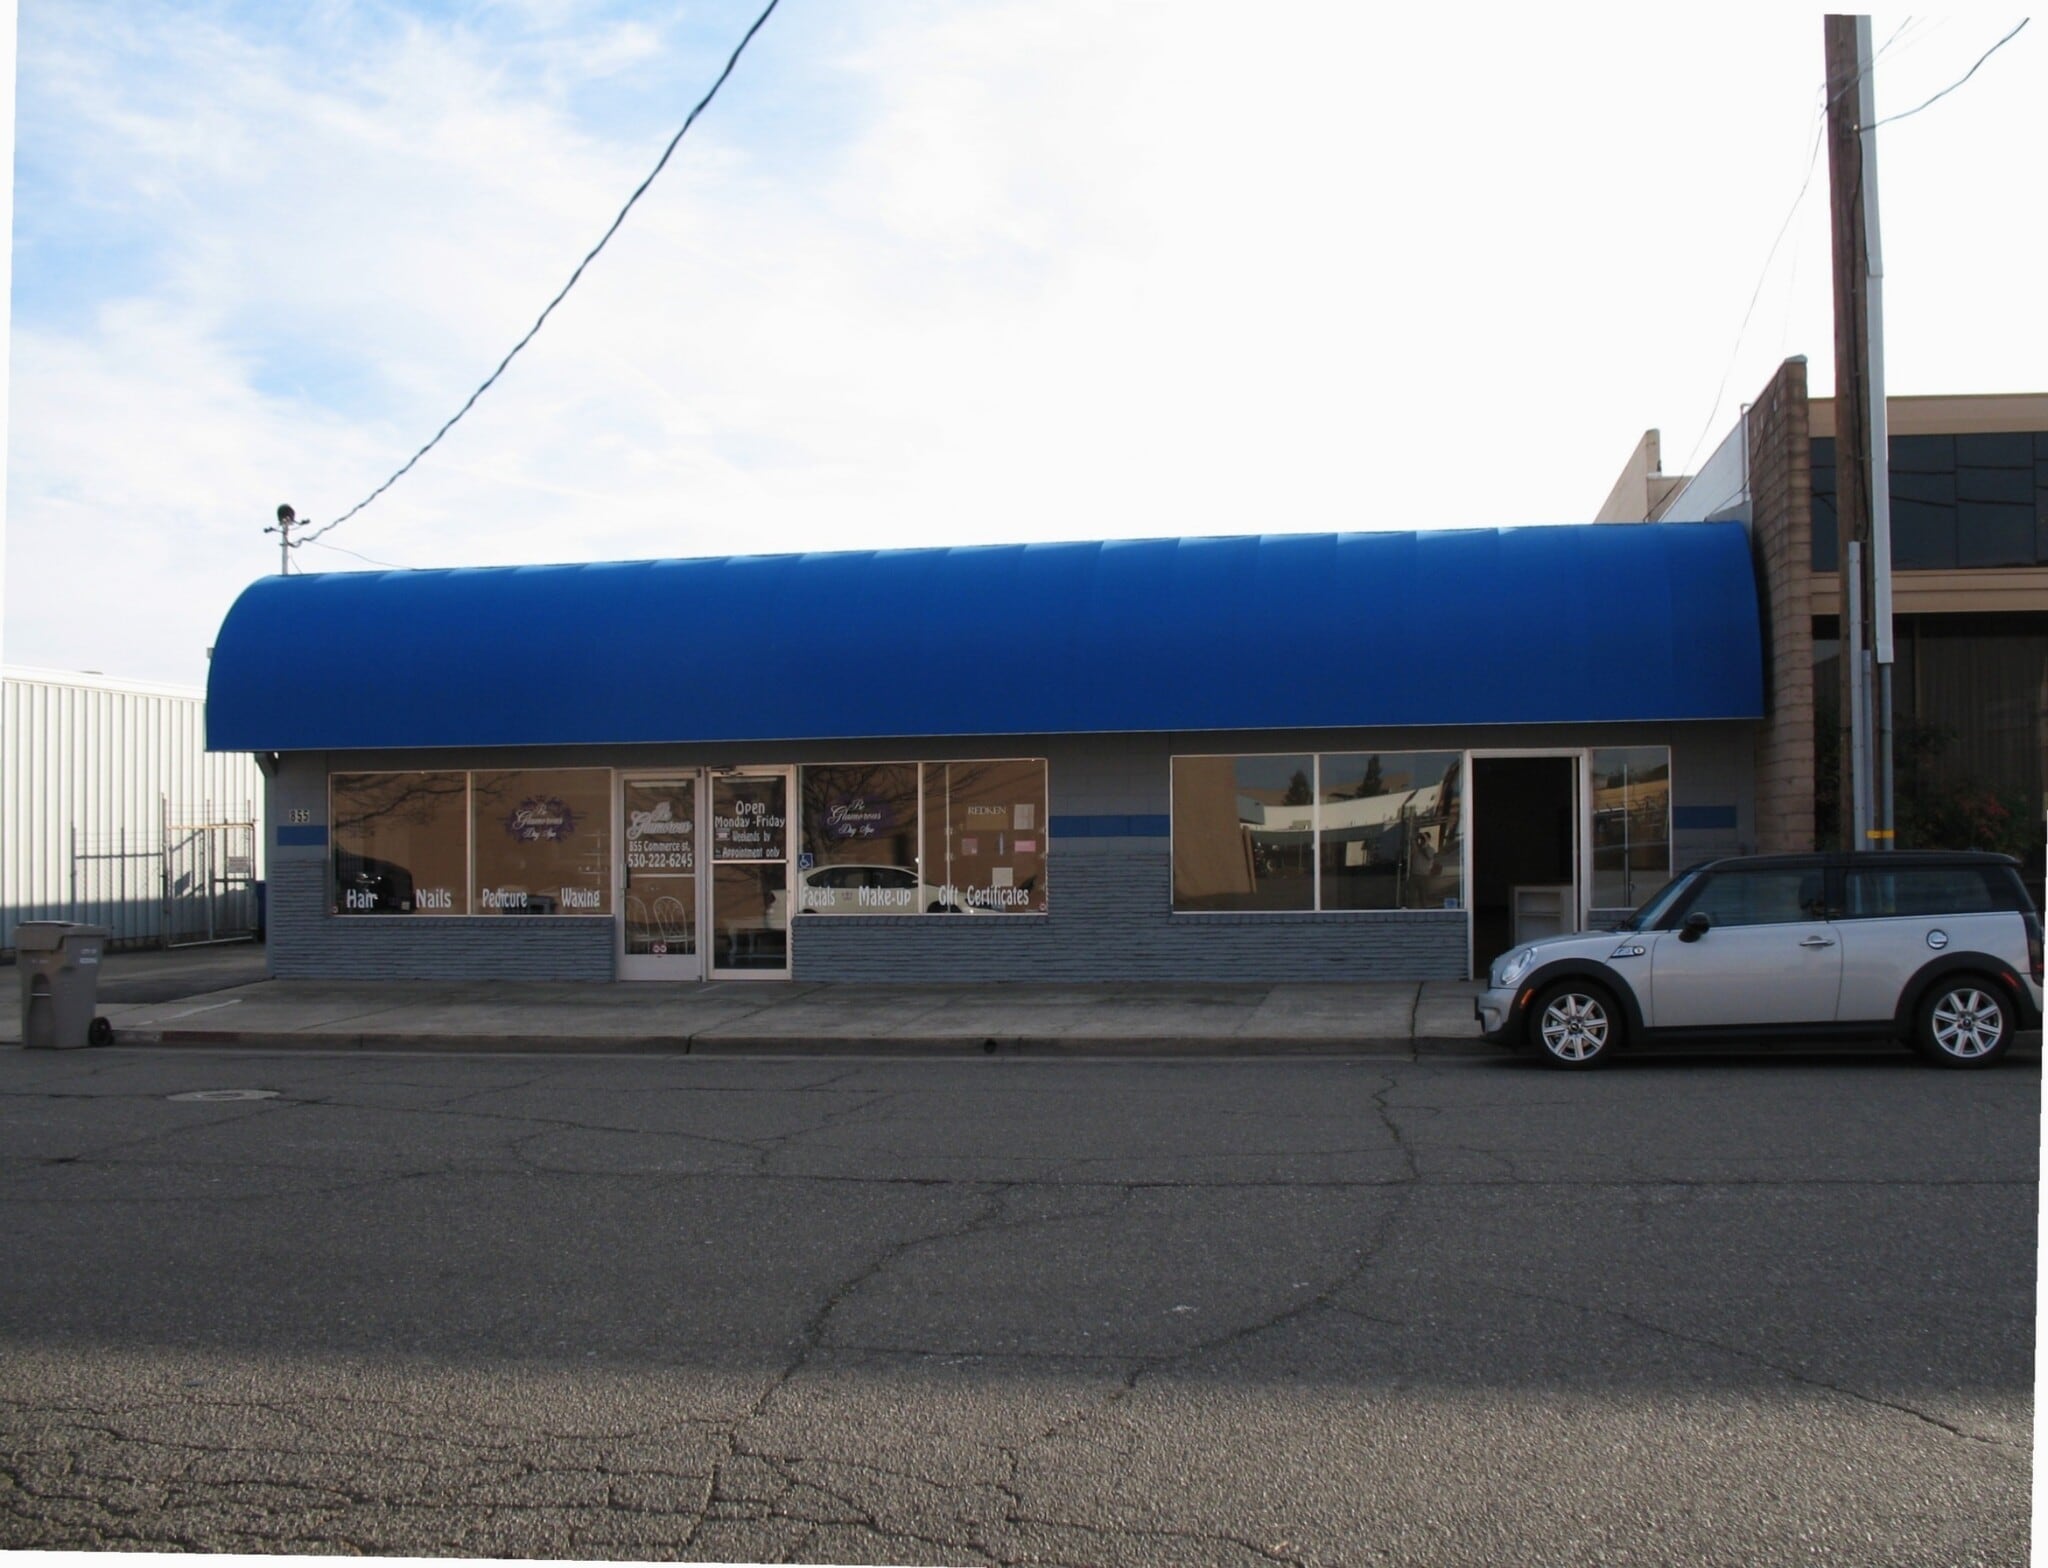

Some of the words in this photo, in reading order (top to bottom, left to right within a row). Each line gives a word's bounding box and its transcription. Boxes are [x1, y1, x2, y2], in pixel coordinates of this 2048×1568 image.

[289, 809, 310, 823] 855
[735, 800, 765, 815] Open
[827, 805, 882, 825] Glamorous
[967, 806, 1007, 815] REDKEN
[626, 810, 693, 840] Glamorous
[714, 816, 750, 828] Monday
[629, 841, 643, 852] 855
[643, 841, 681, 852] Commerce
[722, 847, 764, 859] Appointment
[765, 847, 780, 858] only
[627, 853, 694, 868] 530-222-6245
[346, 888, 378, 908] Hair
[415, 888, 452, 908] Nails
[482, 888, 528, 908] Pedicure
[561, 888, 600, 908] Waxing
[802, 886, 836, 906] Facials
[859, 885, 911, 907] Make-up
[967, 885, 1030, 906] Certificates
